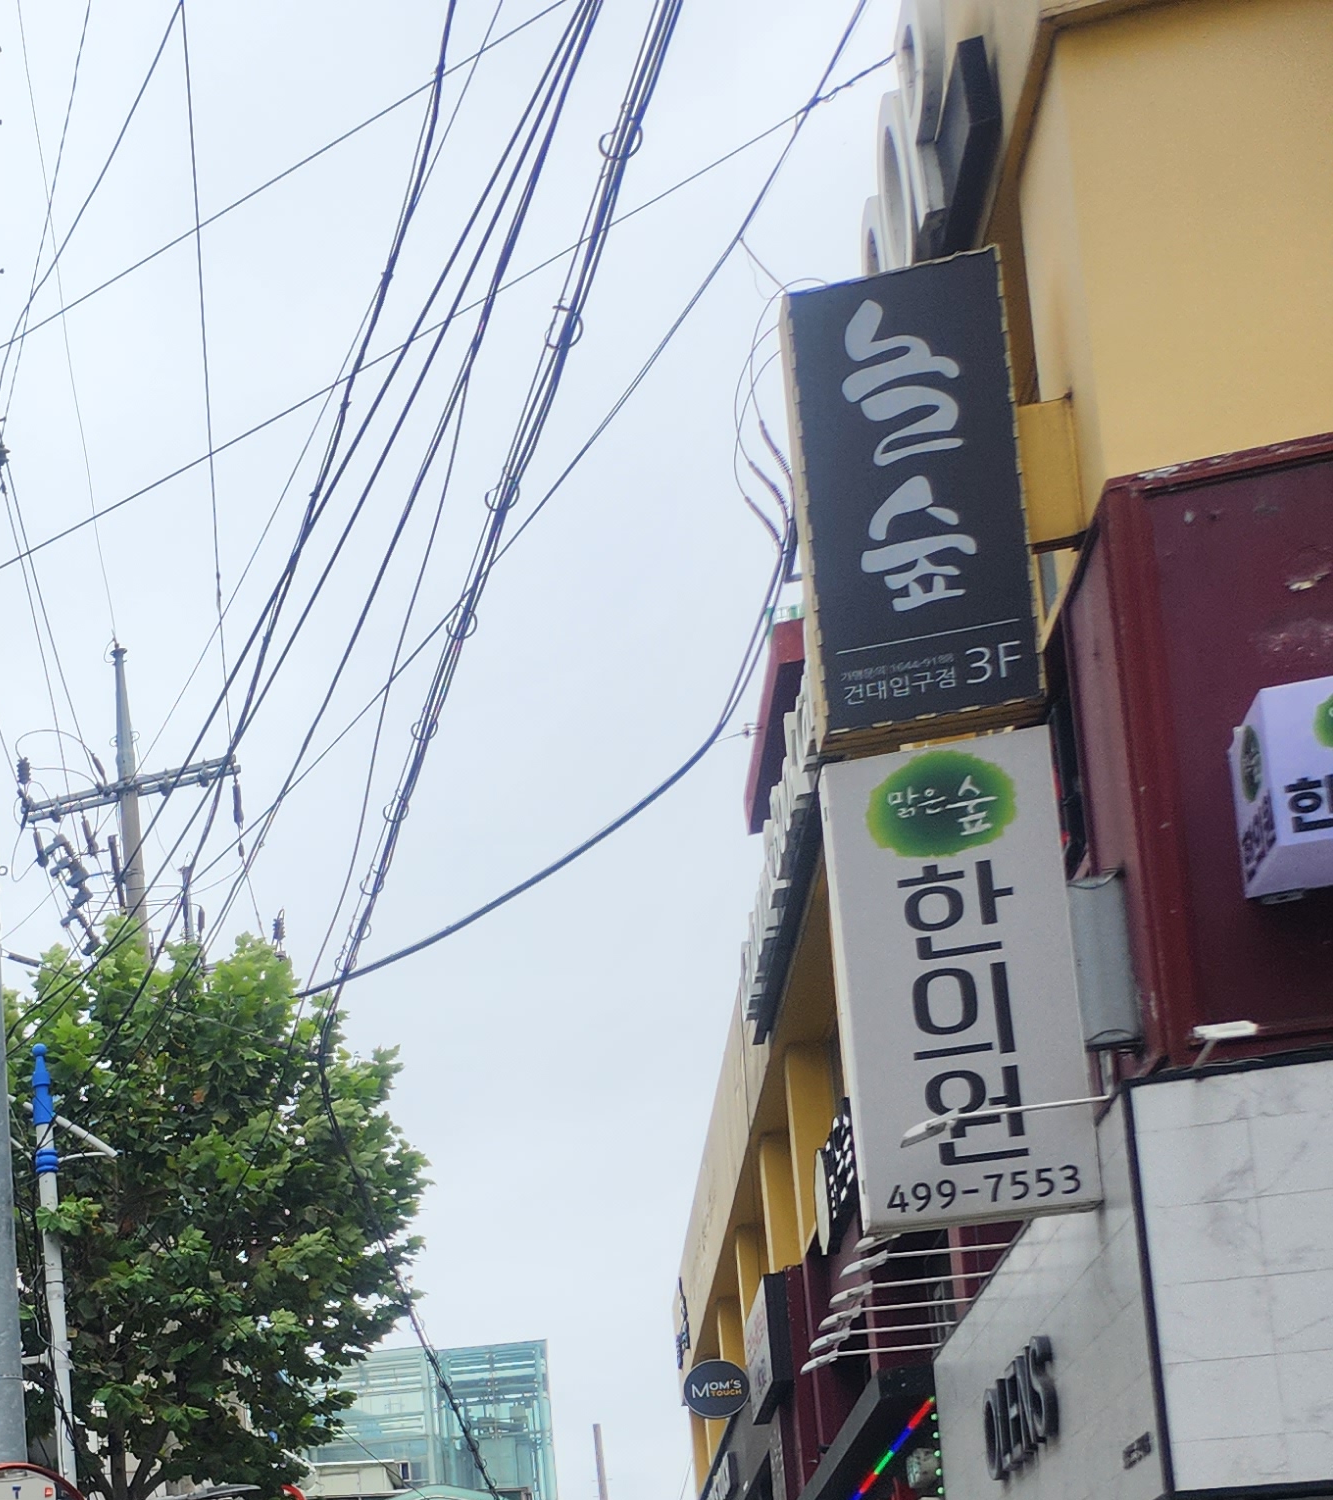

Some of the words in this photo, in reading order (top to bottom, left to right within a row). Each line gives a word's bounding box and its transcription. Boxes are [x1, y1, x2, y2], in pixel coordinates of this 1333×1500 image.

[843, 667, 957, 706] 건대입구점
[965, 641, 1023, 685] 3F
[896, 859, 1030, 1167] 한의원
[886, 1164, 1082, 1214] 499-7553
[691, 1379, 742, 1399] MOM'S
